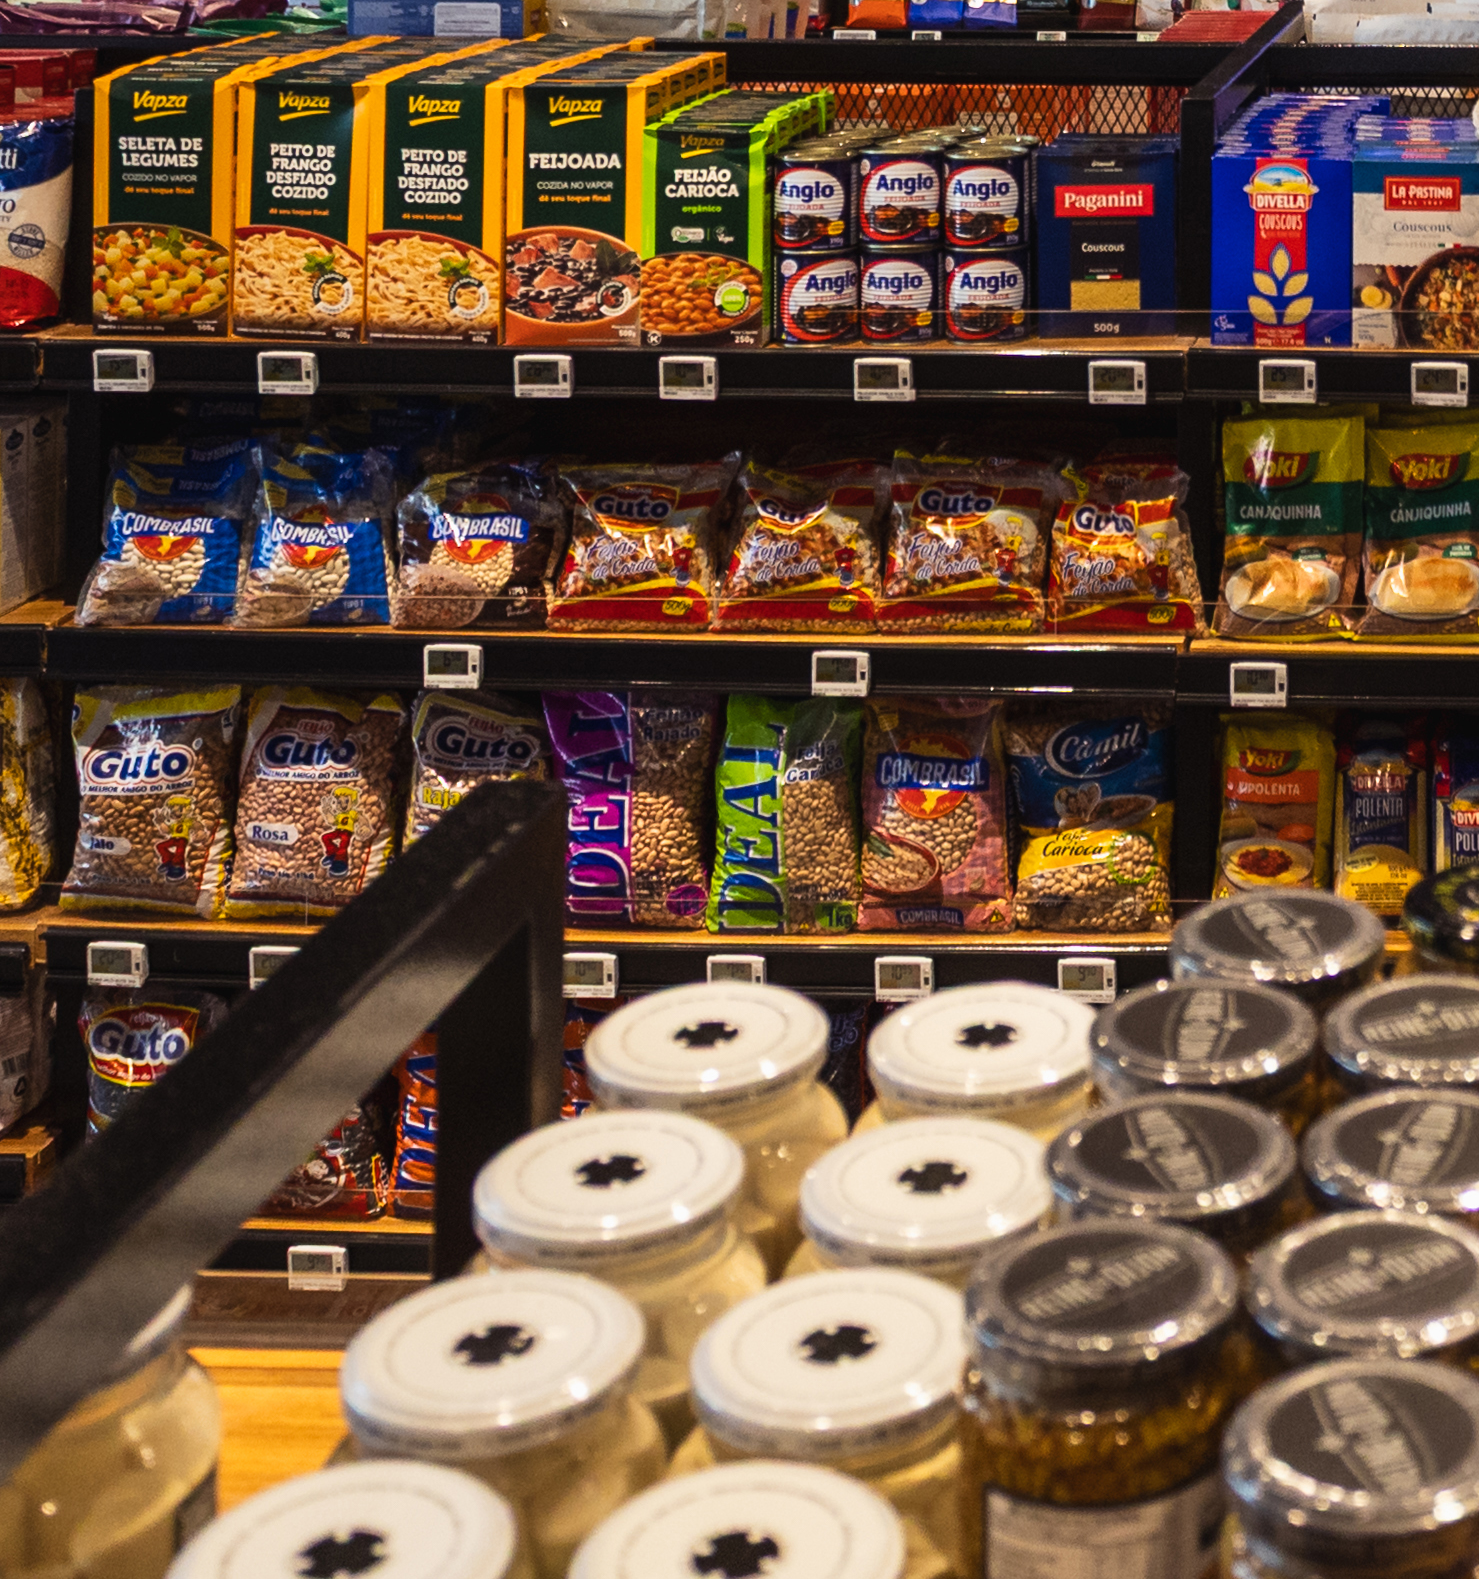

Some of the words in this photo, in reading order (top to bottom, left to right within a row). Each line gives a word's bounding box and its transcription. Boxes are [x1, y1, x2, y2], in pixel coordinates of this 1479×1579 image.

[133, 90, 188, 110] Vapza
[548, 96, 604, 115] Vapza
[118, 137, 176, 151] SELETA
[180, 138, 203, 151] DE
[680, 135, 725, 149] Vapza
[270, 144, 313, 157] PEITO
[316, 144, 335, 158] DE
[401, 149, 443, 163] PEITO
[446, 150, 467, 163] DE
[122, 153, 198, 168] LEGUMES
[272, 158, 332, 171] FRANGO
[529, 153, 621, 169] FEIJOADA
[403, 162, 464, 176] FRANGO
[674, 166, 731, 183] FEIJÃO
[122, 173, 151, 182] COZIDO
[153, 173, 165, 182] NO
[167, 173, 197, 183] VAPOR
[266, 172, 337, 186] DESFIADO
[397, 177, 469, 191] DESFIADO
[876, 174, 934, 192] Anglo
[272, 185, 329, 200] COZIDO
[536, 181, 568, 190] COZIDA
[570, 181, 585, 190] NO
[587, 181, 614, 190] VAPOR
[665, 184, 739, 198] CARIOCA
[1392, 185, 1407, 198] LA
[1409, 185, 1453, 200] PASTINA
[404, 190, 462, 204] COZIDO
[591, 194, 611, 202] final
[1063, 192, 1144, 211] Paganini
[1256, 195, 1306, 209] DIVELLA
[682, 204, 722, 214] orgânico
[1393, 221, 1452, 233] Couscous
[1081, 243, 1125, 254] Couscous
[960, 271, 1018, 291] Anglo
[1094, 323, 1119, 334] 500g
[1240, 504, 1321, 520] CANJIQUINHA
[122, 511, 215, 537] COMBRASIL
[264, 736, 358, 771] Guto
[89, 746, 191, 783] Guto
[880, 756, 984, 786] COMBRASIL
[252, 825, 289, 843] Rosa
[1042, 841, 1103, 857] Carioca
[90, 1021, 186, 1060] Guto
